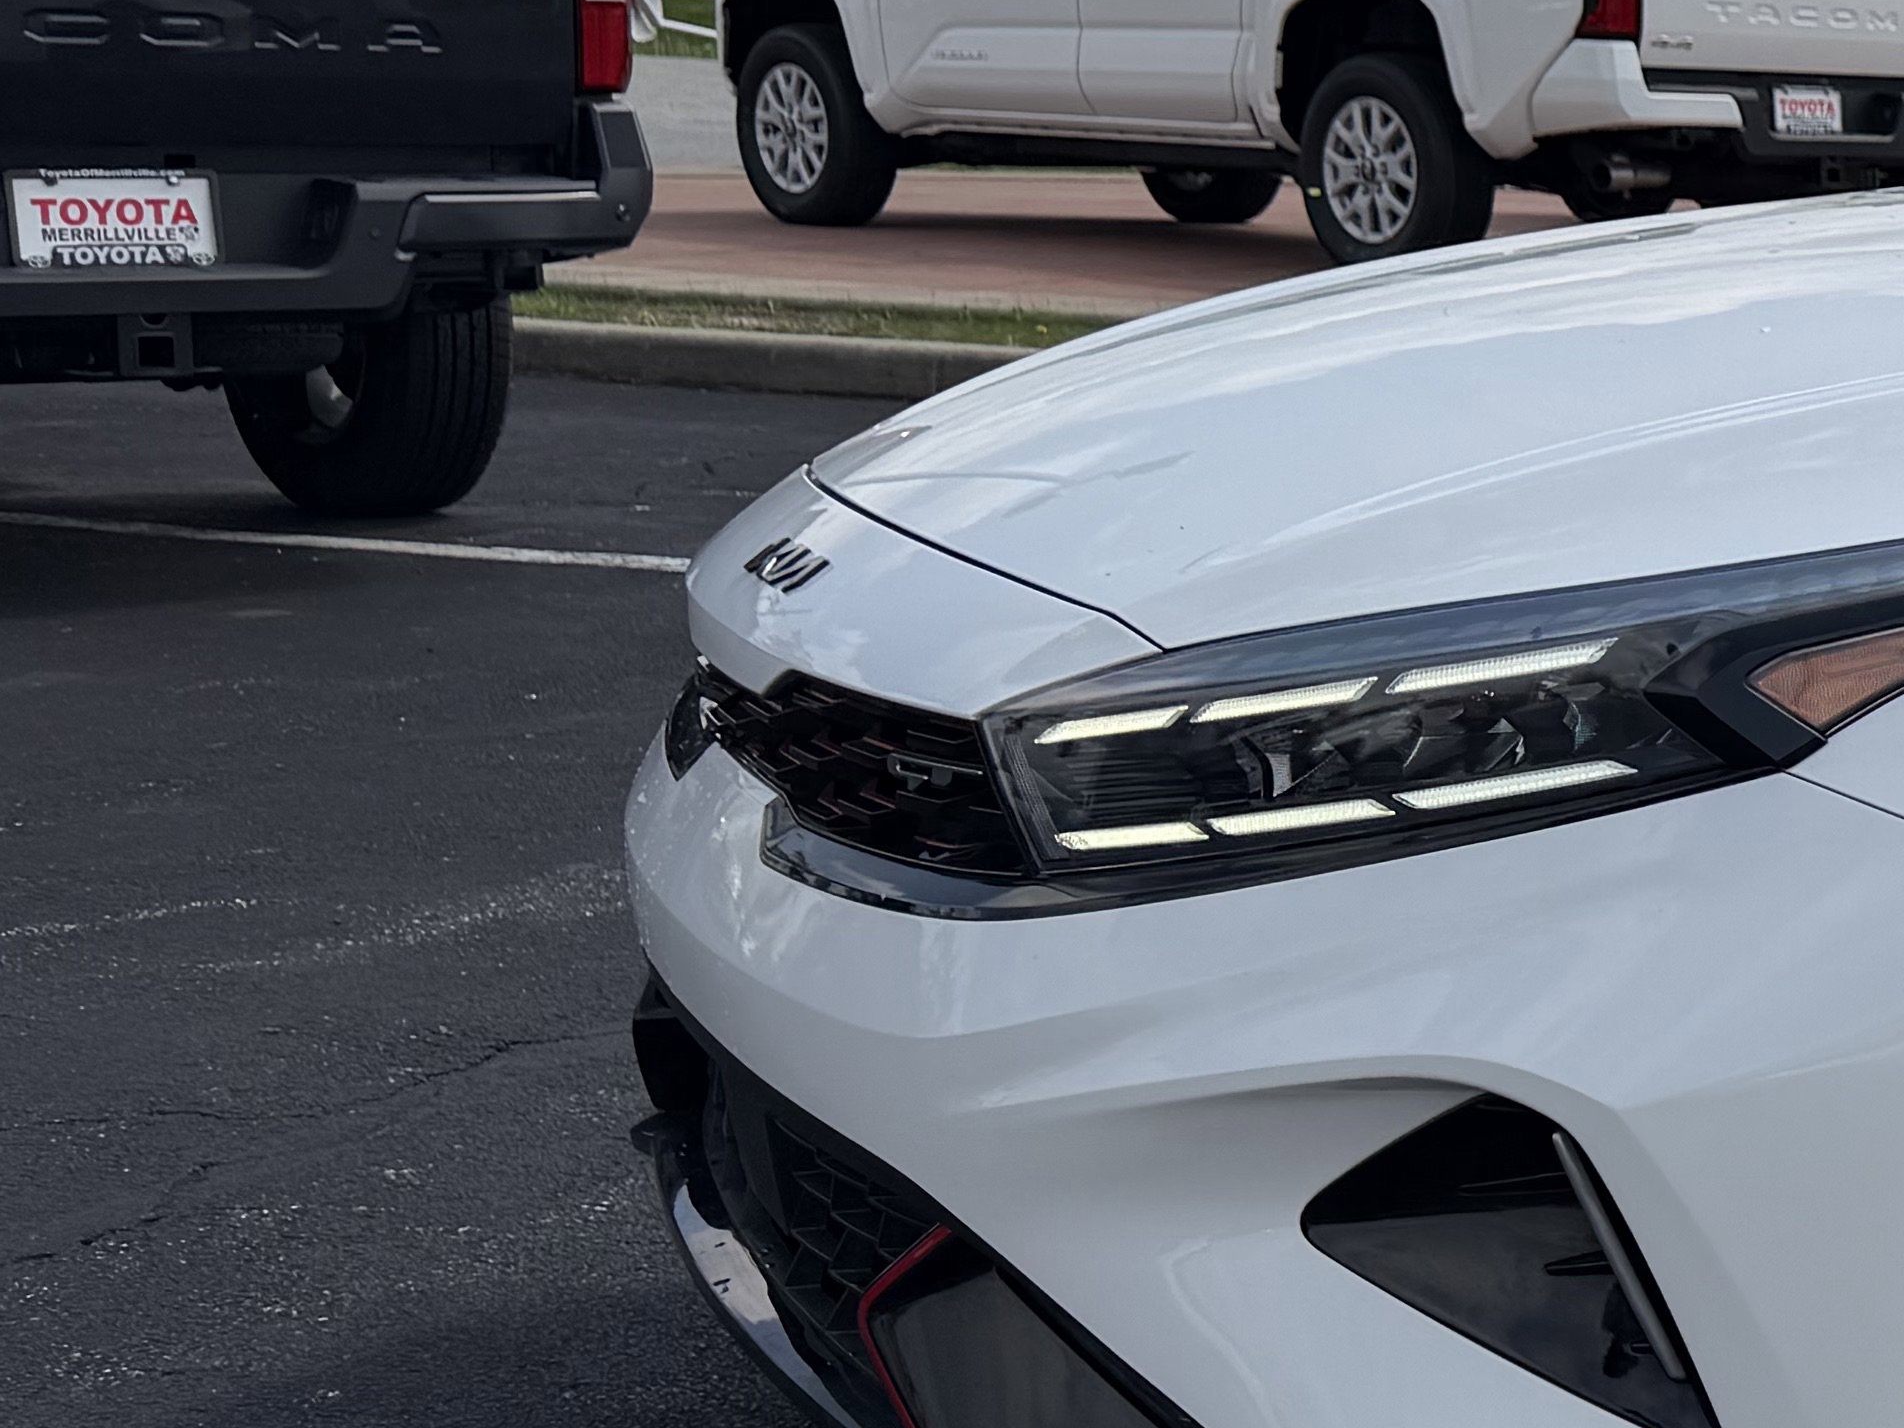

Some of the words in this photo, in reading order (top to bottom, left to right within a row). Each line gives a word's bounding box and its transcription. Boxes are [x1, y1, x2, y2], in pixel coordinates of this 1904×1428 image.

[1779, 98, 1836, 117] TOYOTA
[30, 198, 198, 225] TOYOTA
[41, 227, 178, 242] MERRILLVILLE
[56, 246, 165, 265] TOYOTA
